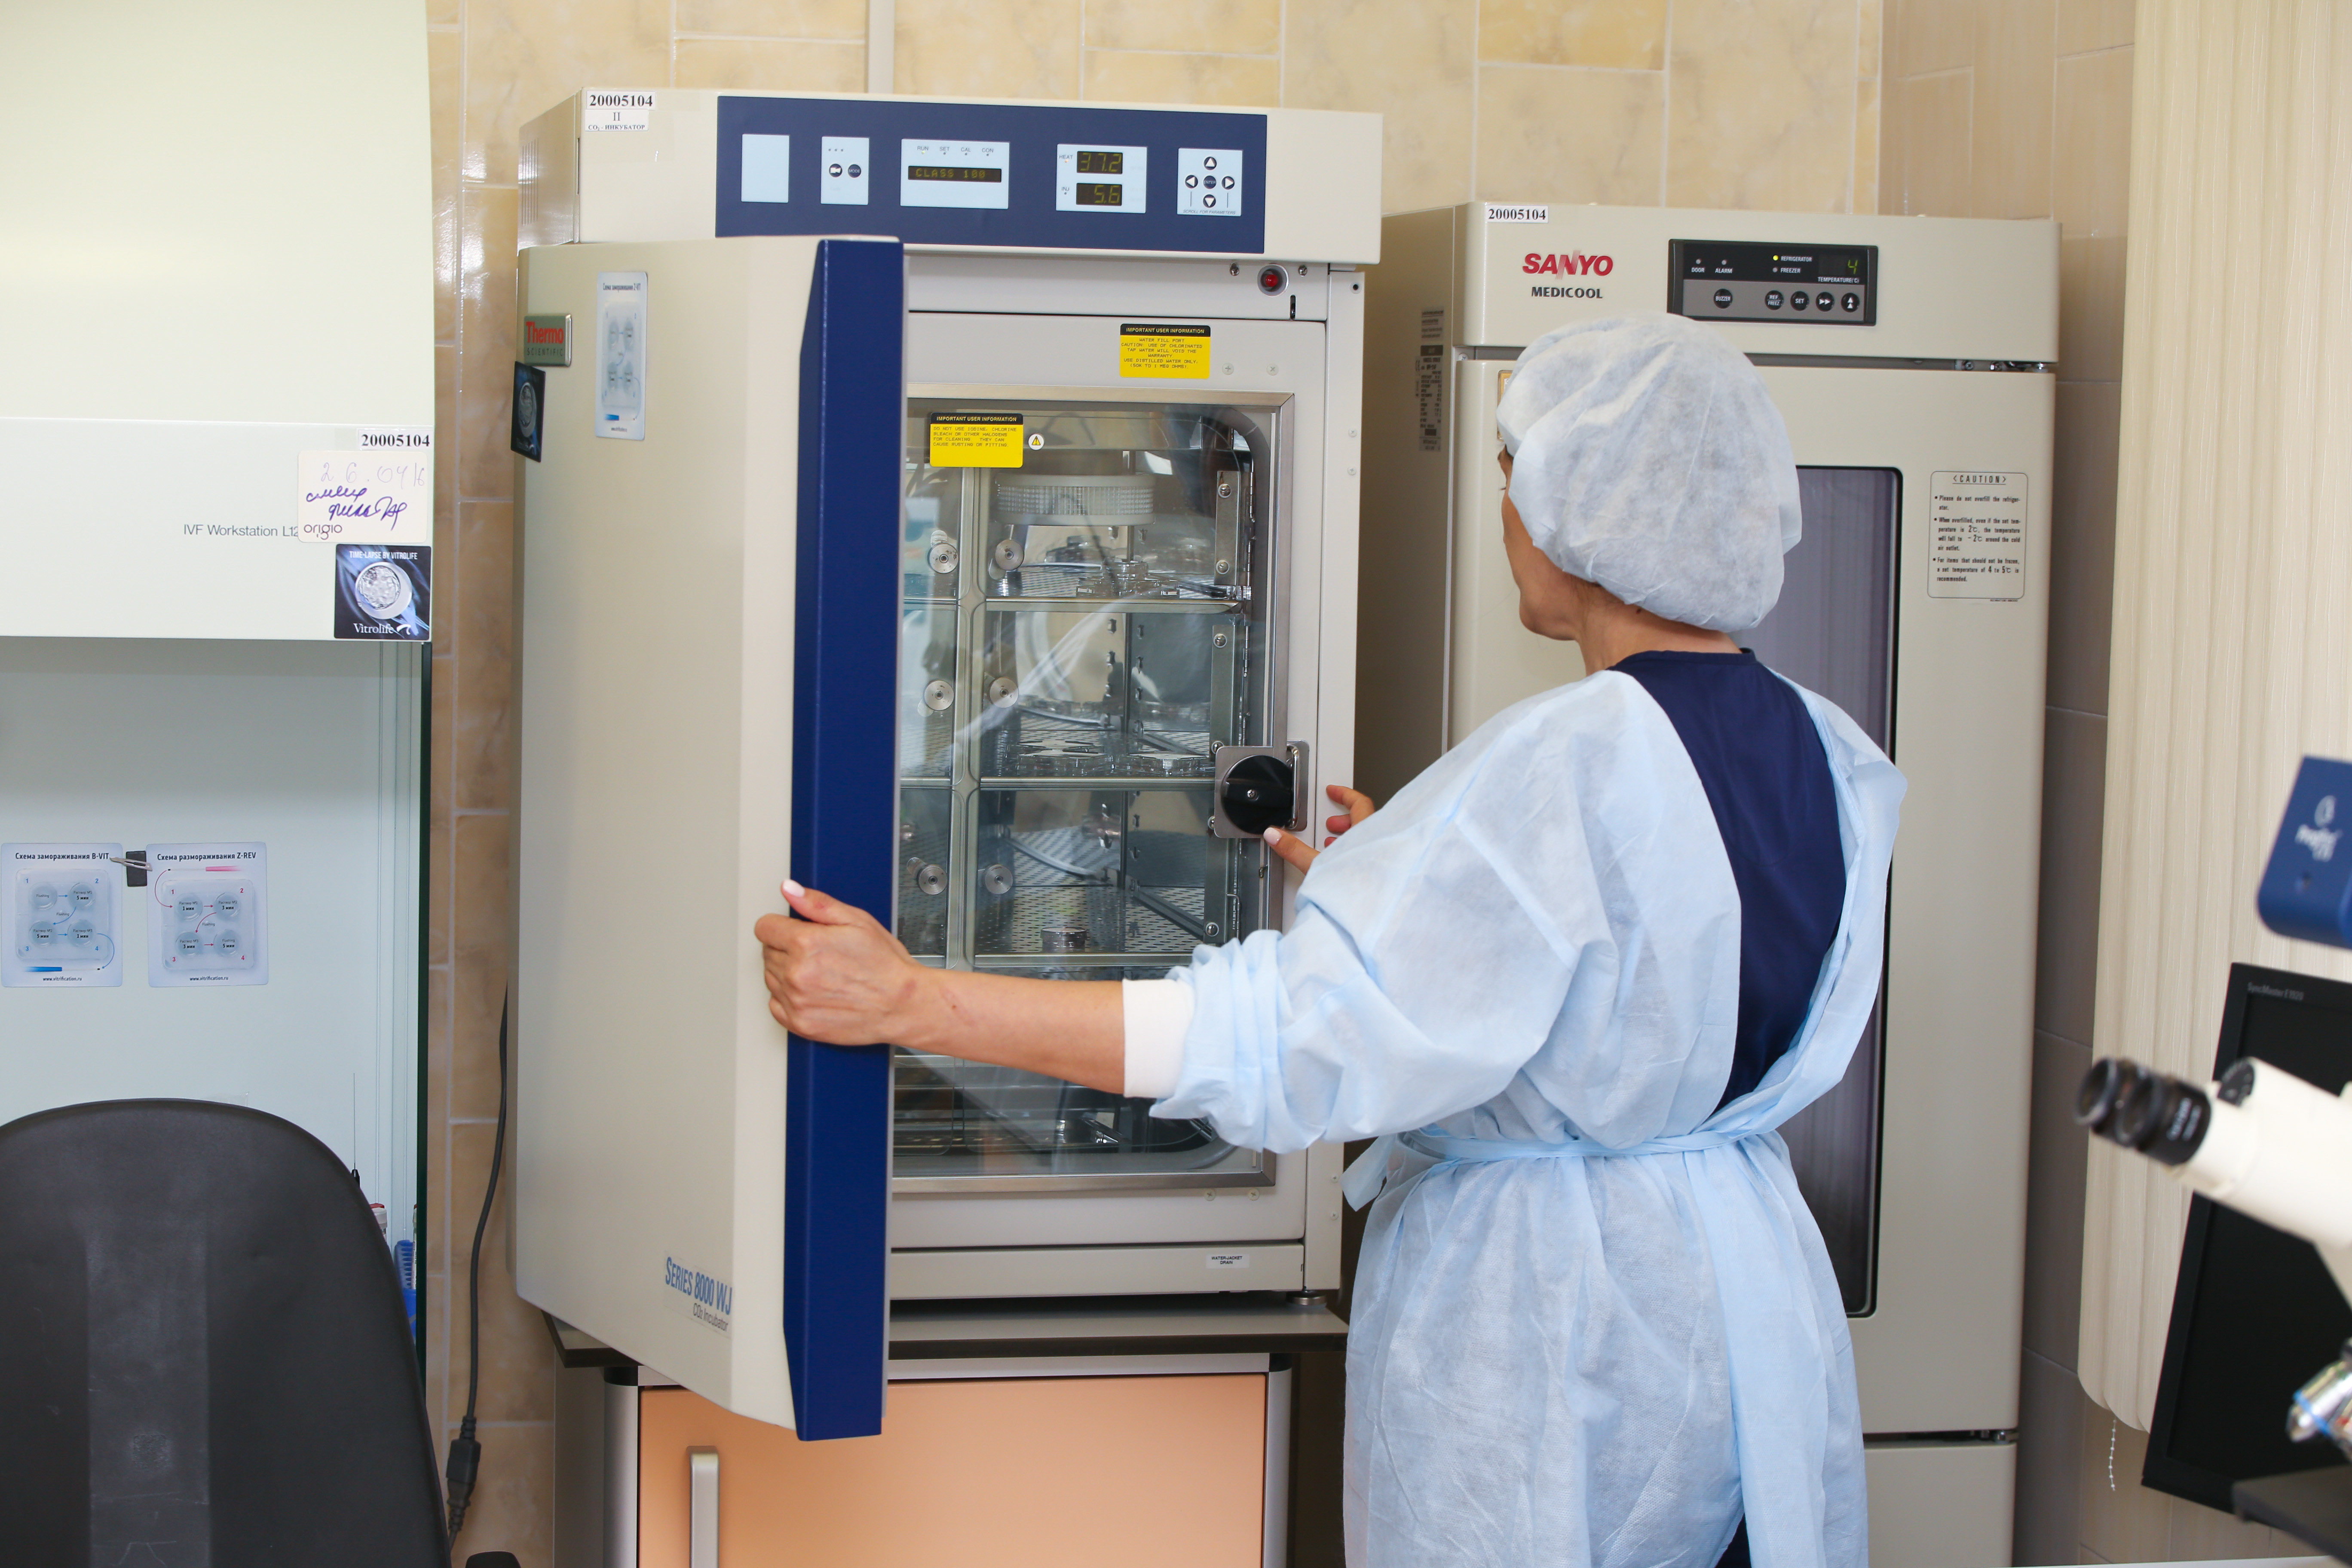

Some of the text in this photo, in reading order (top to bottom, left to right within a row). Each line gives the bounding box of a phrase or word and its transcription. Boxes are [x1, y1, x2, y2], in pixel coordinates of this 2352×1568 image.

[590, 95, 652, 107] 20005104
[613, 112, 621, 121] II
[916, 168, 985, 178] CLASS 100
[1488, 208, 1546, 220] 20005104
[1522, 249, 1613, 280] SANYO
[1848, 260, 1858, 274] 4
[1531, 287, 1603, 298] MEDICOOL
[526, 322, 564, 343] Thermo
[527, 347, 563, 356] SCIENTIFIC
[361, 434, 430, 447] 20005104
[184, 524, 203, 535] IVF
[207, 525, 278, 536] Workstation
[304, 524, 343, 540] origio
[354, 623, 394, 634] Vitrolife
[179, 853, 235, 862] размораживания
[695, 1272, 714, 1306] 8000
[717, 1281, 733, 1315] WJ
[704, 1308, 728, 1332] Incubator
